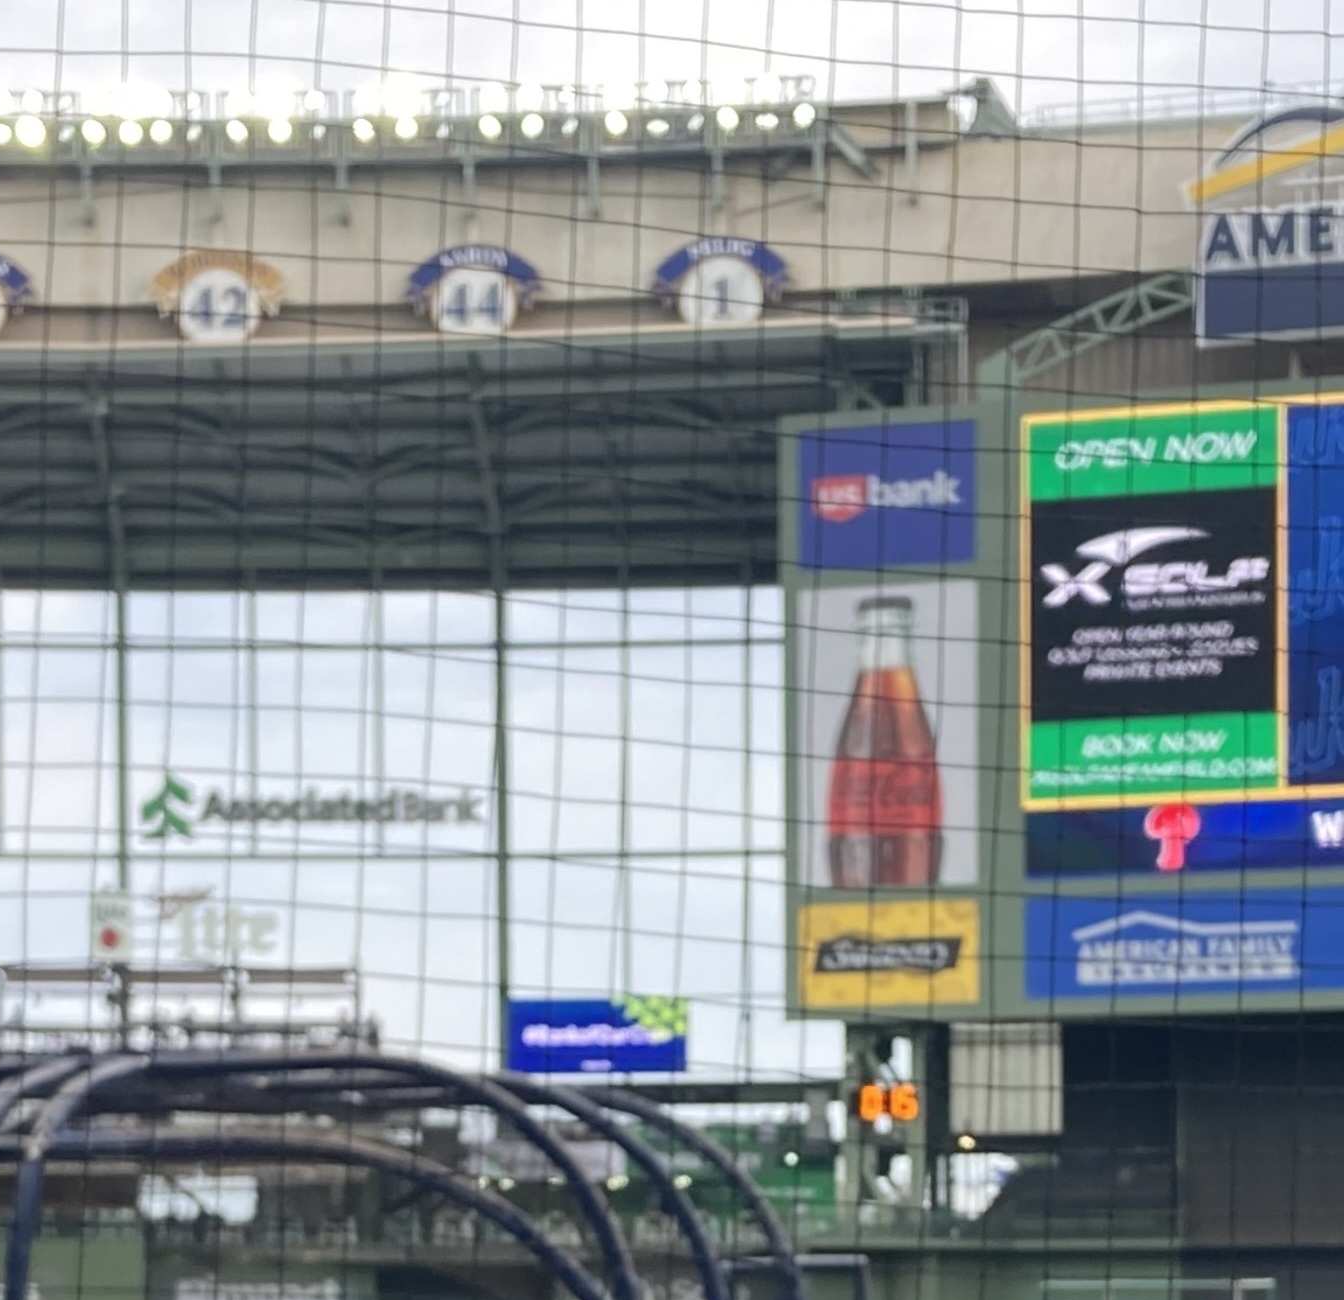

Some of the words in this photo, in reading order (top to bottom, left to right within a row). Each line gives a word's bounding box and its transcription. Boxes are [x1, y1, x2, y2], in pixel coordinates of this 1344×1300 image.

[189, 286, 248, 330] 42
[441, 281, 503, 327] 44
[715, 277, 731, 317] 1
[1055, 437, 1156, 471] OPEN
[1163, 429, 1258, 463] NOW
[866, 470, 960, 507] bank
[200, 786, 397, 823] Associated
[399, 784, 485, 823] Bank
[1076, 937, 1201, 963] AMERICAN
[1206, 934, 1298, 959] FAMILY
